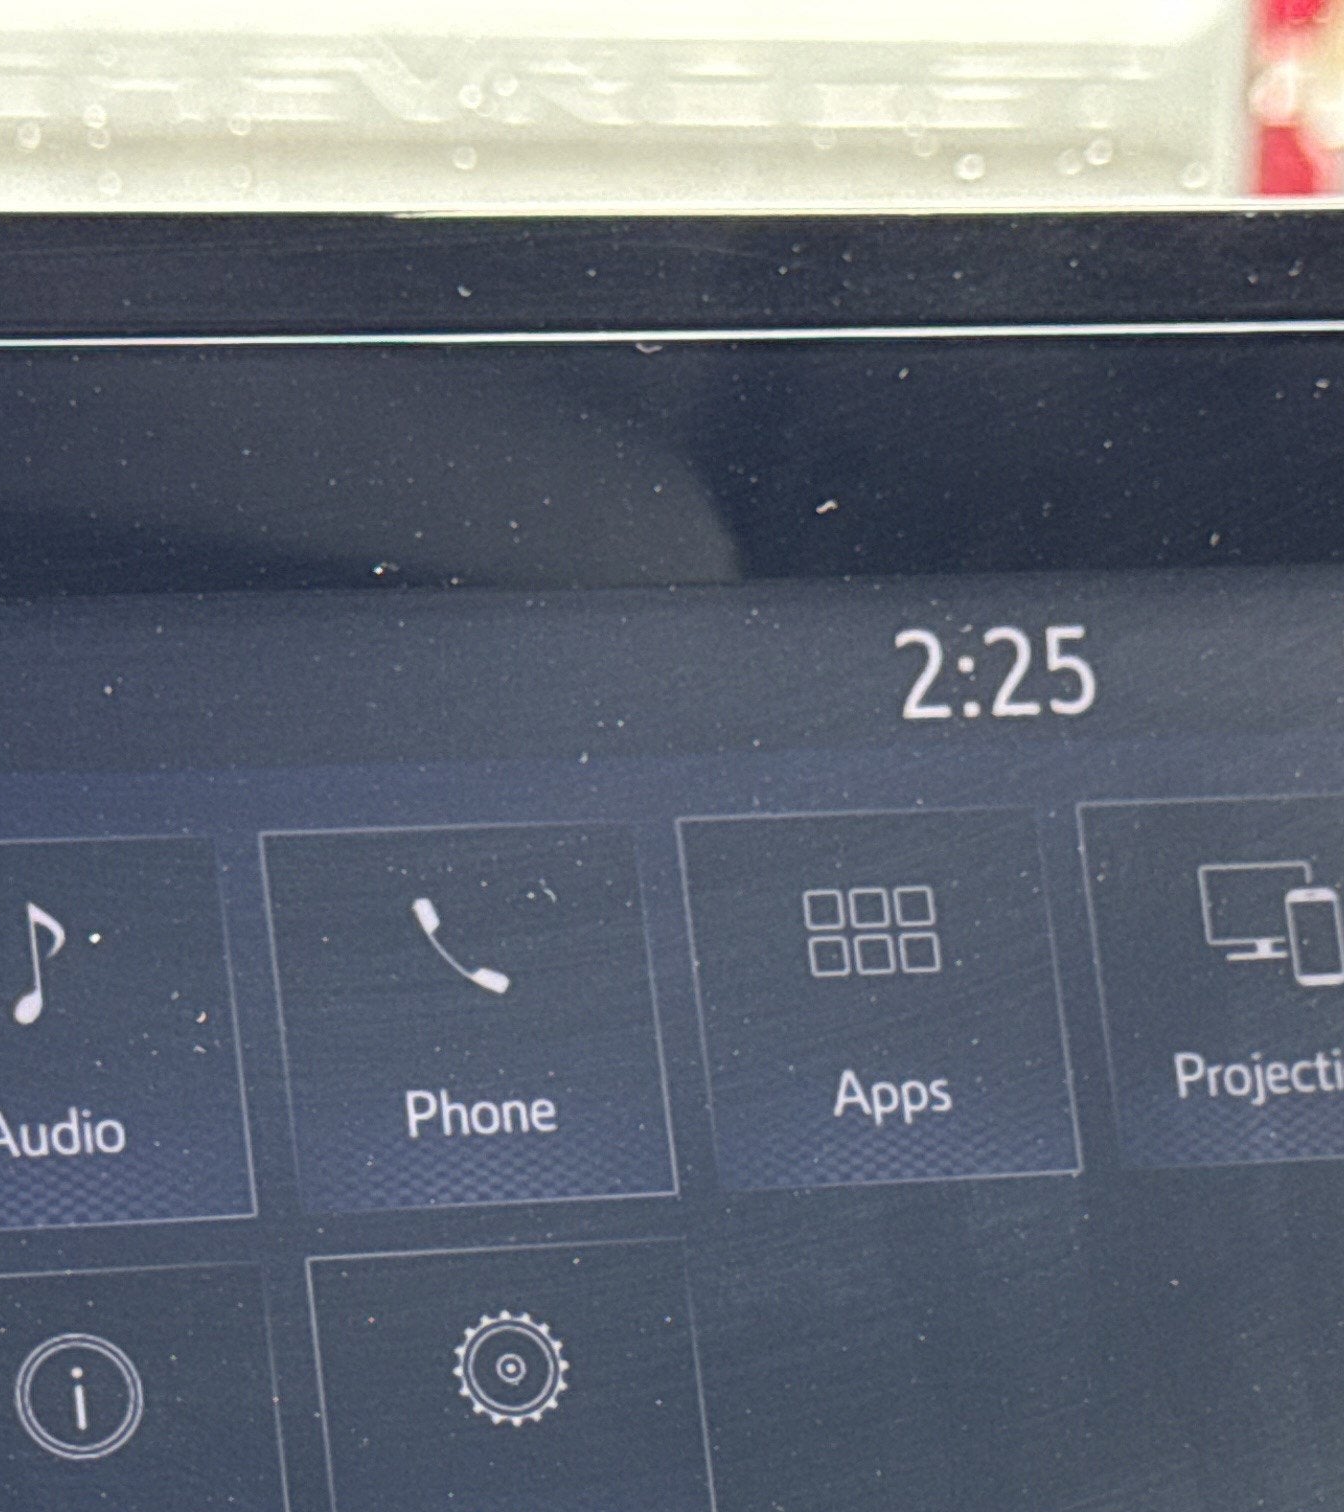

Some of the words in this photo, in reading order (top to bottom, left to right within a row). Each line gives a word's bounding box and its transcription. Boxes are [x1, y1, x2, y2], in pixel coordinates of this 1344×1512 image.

[894, 625, 1097, 719] 2:25
[403, 1088, 558, 1139] Phone
[833, 1068, 954, 1126] Apps
